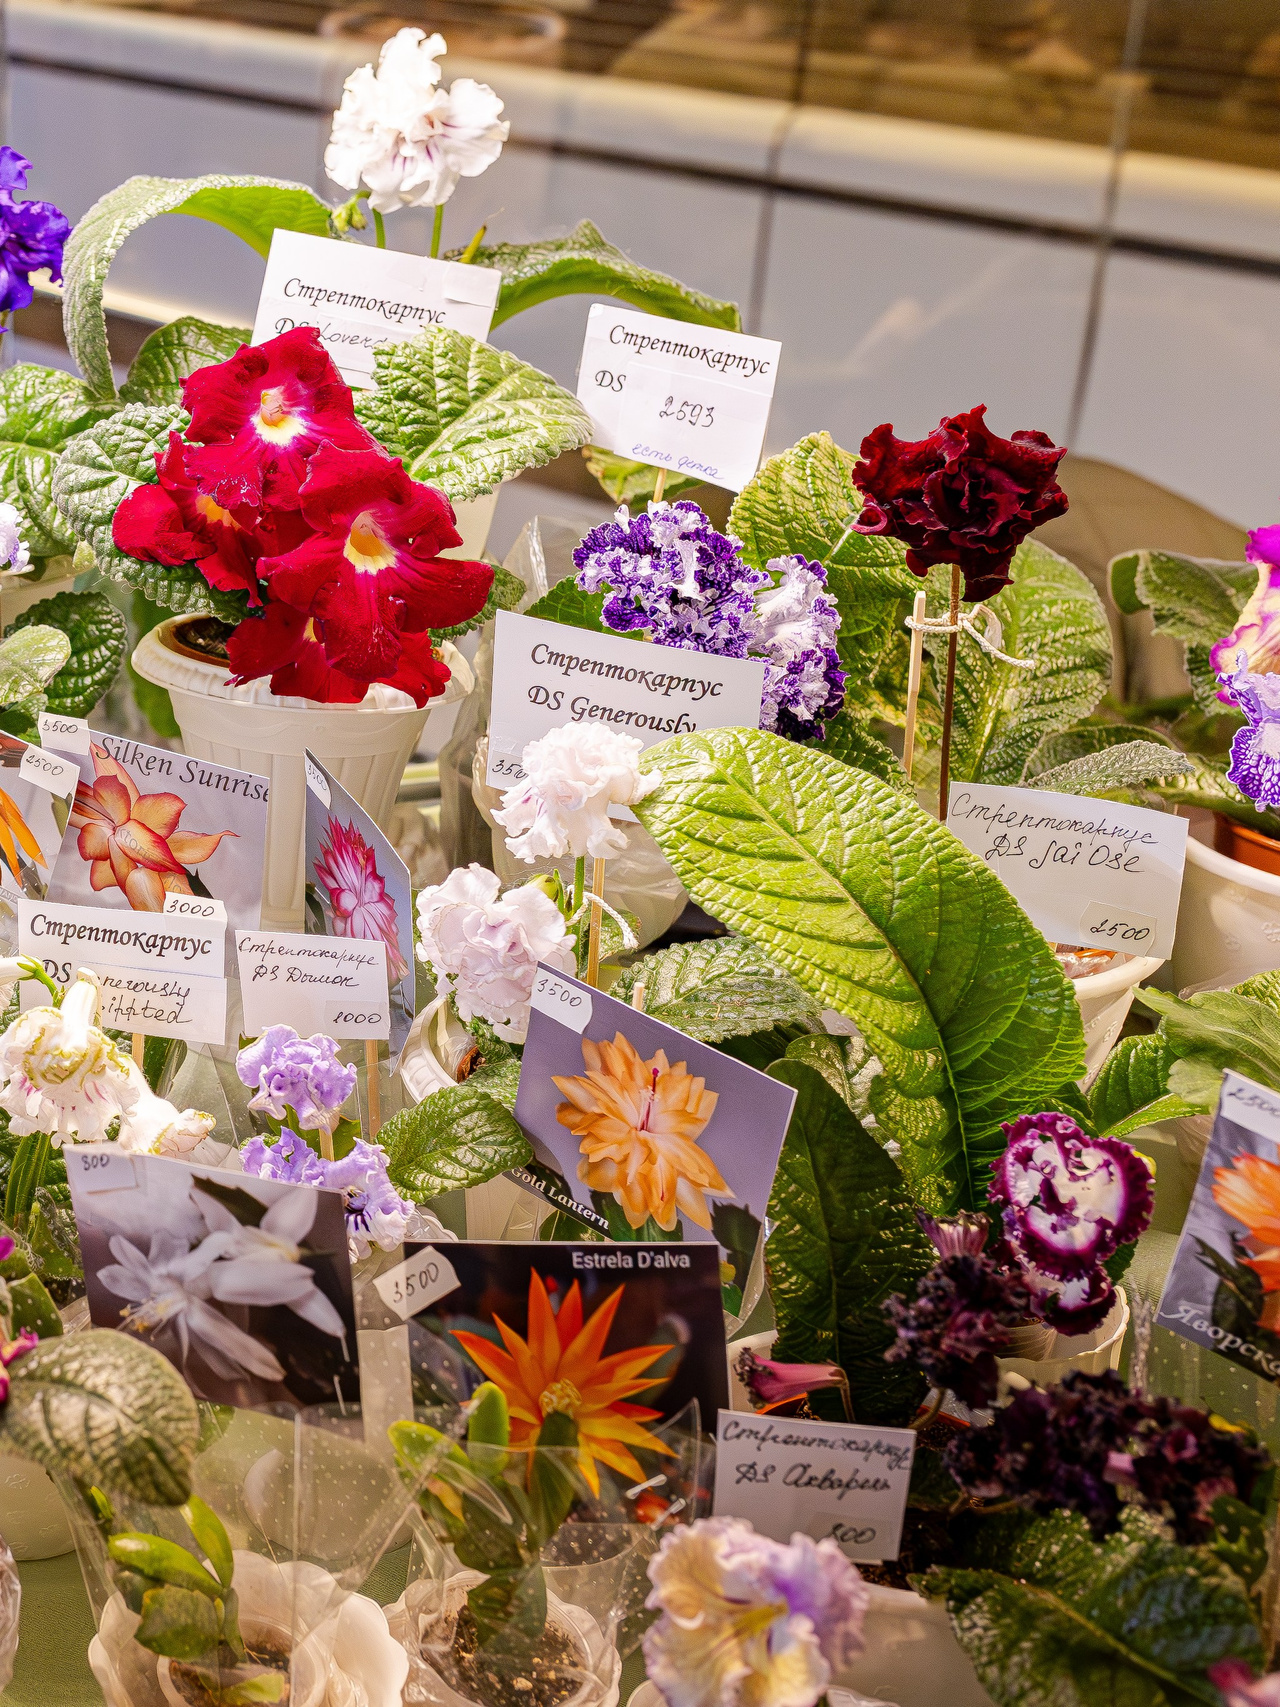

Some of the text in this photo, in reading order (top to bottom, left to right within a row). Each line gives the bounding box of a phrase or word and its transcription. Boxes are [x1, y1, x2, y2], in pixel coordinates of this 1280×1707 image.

[284, 277, 447, 328] Стрептокарпус
[609, 324, 771, 378] Стрептокарпус
[594, 369, 716, 428] DS 2593
[530, 642, 724, 702] Стрептокарпус
[527, 685, 565, 711] DS
[25, 754, 65, 776] 2500
[95, 736, 270, 803] Silken Sunrise
[166, 899, 215, 917] 3000
[1089, 918, 1150, 941] 2500
[30, 913, 213, 960] Стрептокарпус
[43, 958, 191, 1006] DS nerously
[537, 978, 582, 1007] 3500
[81, 1154, 110, 1171] 800
[510, 1166, 610, 1231] Gold Lantern
[572, 1251, 692, 1270] Estrela D'alva
